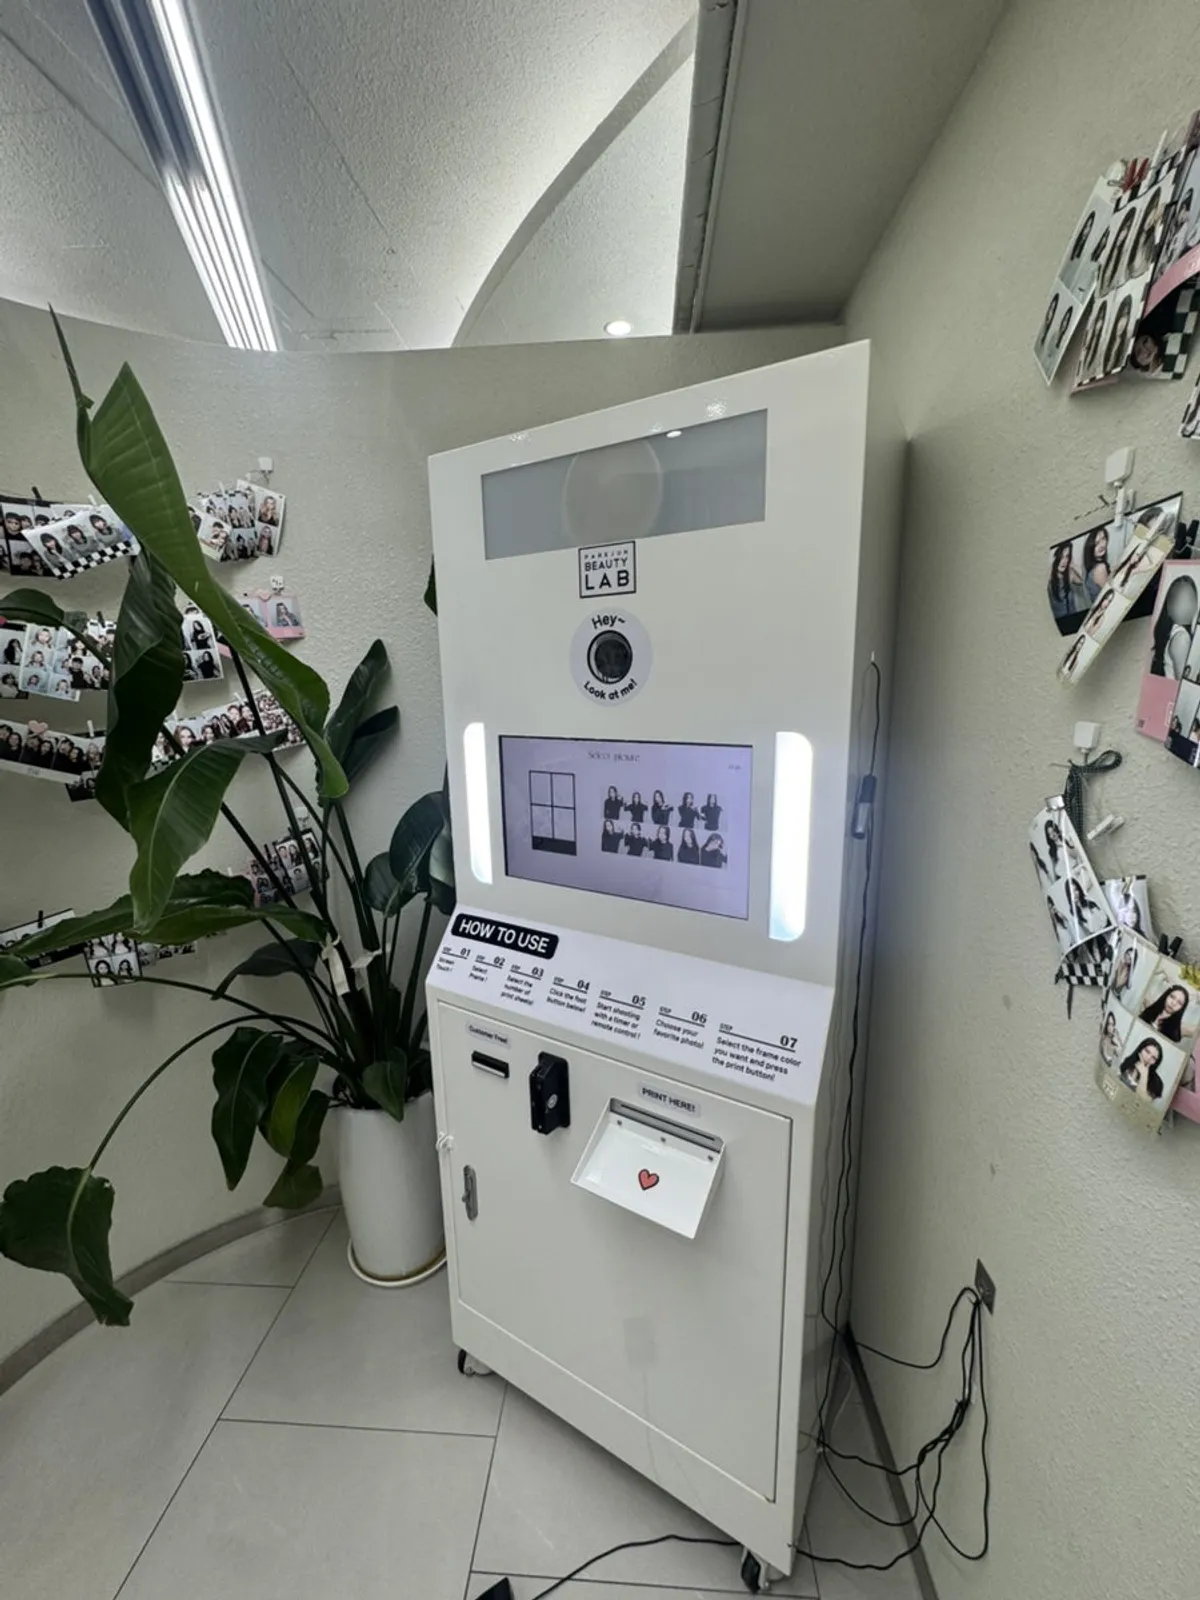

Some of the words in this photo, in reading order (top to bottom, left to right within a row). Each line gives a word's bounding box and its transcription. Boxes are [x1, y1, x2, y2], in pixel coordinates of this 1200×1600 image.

[585, 557, 628, 571] BEAUTY
[585, 570, 629, 590] LAB
[584, 681, 606, 700] Look
[608, 689, 619, 700] at
[620, 678, 637, 696] me!
[459, 918, 495, 939] HOW
[497, 926, 516, 944] TO
[518, 932, 550, 953] USE
[460, 947, 471, 957] 01
[493, 955, 506, 967] 02
[531, 966, 544, 978] 03
[549, 987, 564, 997] Click
[577, 979, 590, 991] 04
[546, 995, 566, 1007] button
[631, 994, 647, 1007] 05
[594, 1011, 608, 1020] with
[613, 1016, 631, 1026] timer
[596, 1001, 613, 1012] Start
[612, 1007, 641, 1021] shooting
[691, 1010, 708, 1024] 06
[591, 1019, 613, 1032] remote
[655, 1018, 682, 1033] Choose
[681, 1028, 699, 1037] your
[653, 1027, 680, 1042] favorite
[679, 1036, 704, 1049] photo!
[719, 1022, 733, 1031] STEP
[780, 1034, 799, 1049] 07
[716, 1036, 741, 1050] Select
[741, 1043, 755, 1054] the
[755, 1047, 779, 1061] frame
[779, 1055, 802, 1067] color
[711, 1056, 725, 1067] the
[725, 1061, 745, 1073] print
[745, 1067, 776, 1082] button!
[714, 1047, 728, 1057] you
[729, 1051, 749, 1062] want
[749, 1057, 766, 1068] and
[765, 1062, 788, 1075] press
[641, 1087, 669, 1103] PRINT
[668, 1096, 697, 1113] HERE!
